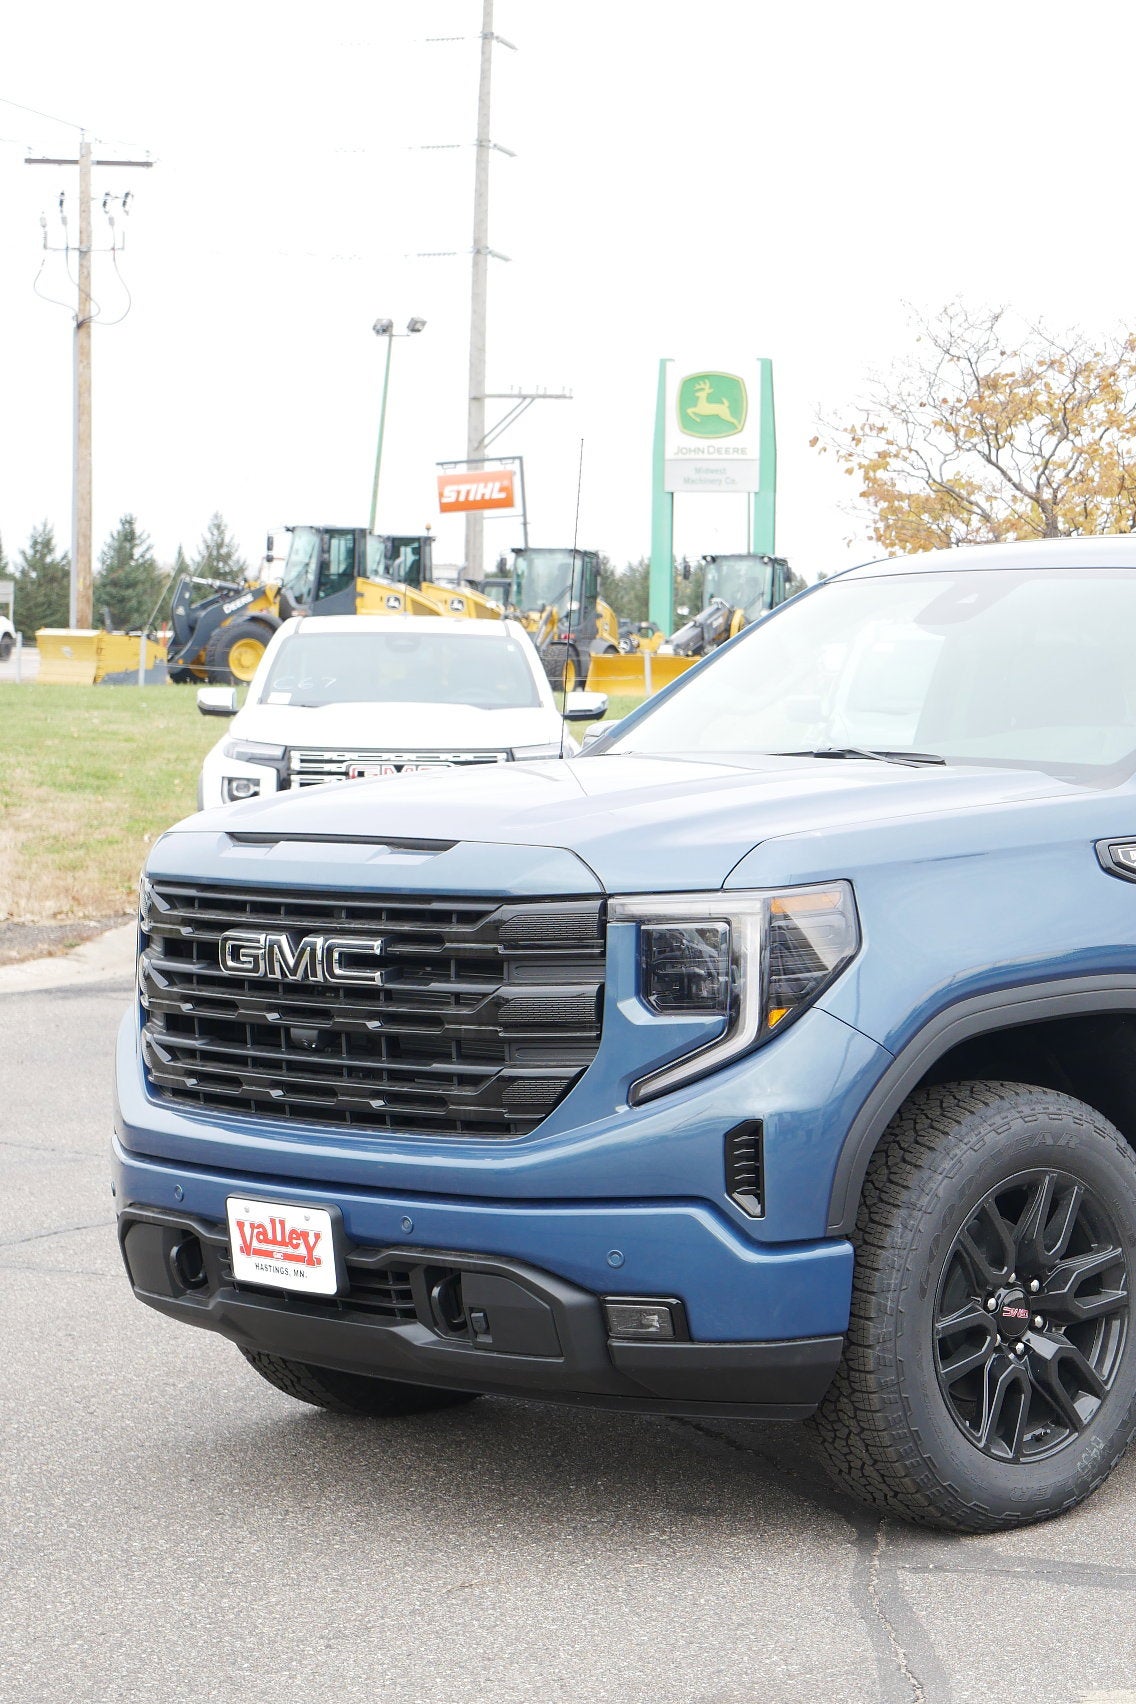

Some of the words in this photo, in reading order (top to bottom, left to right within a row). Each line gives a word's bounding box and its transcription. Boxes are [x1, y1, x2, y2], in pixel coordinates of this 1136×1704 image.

[674, 446, 705, 455] JOHN
[707, 445, 748, 455] DEERE
[441, 481, 507, 503] STIHL
[219, 931, 385, 987] GMC
[254, 1262, 293, 1277] HASTINGS,
